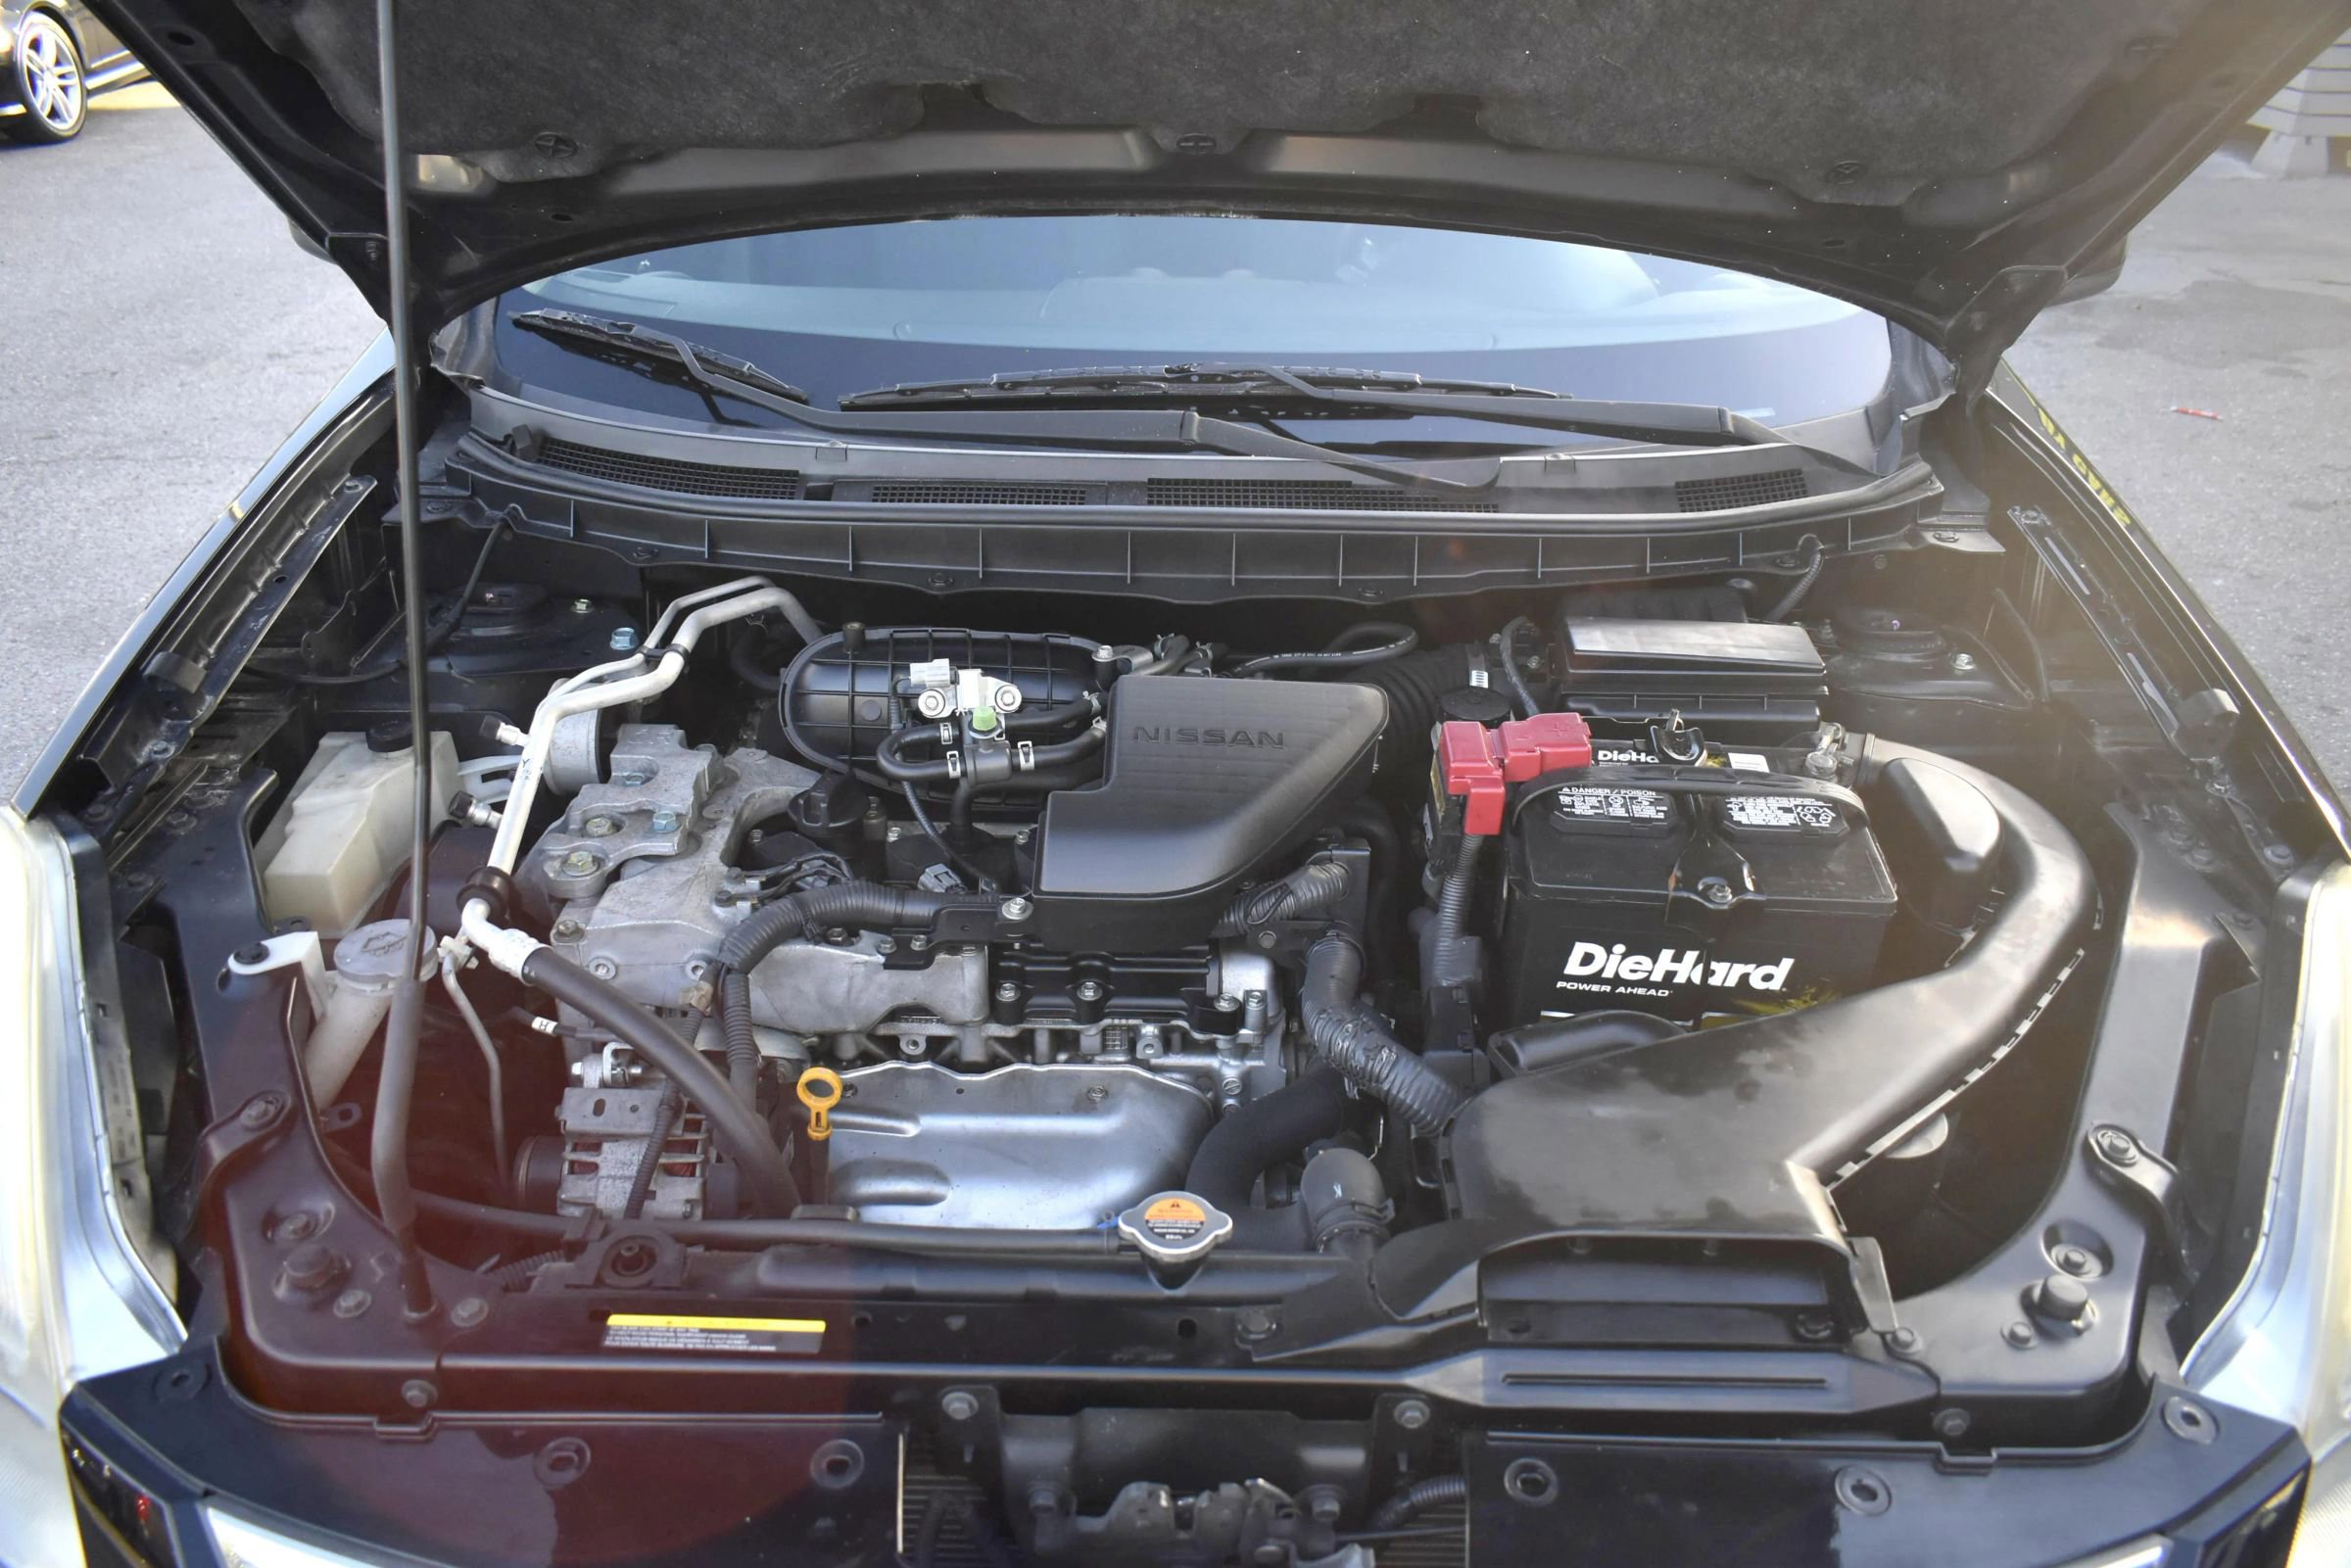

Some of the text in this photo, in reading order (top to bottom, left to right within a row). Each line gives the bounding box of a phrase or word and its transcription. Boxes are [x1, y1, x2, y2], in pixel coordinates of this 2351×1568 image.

[1133, 726, 1285, 749] NISSAN
[1598, 749, 1659, 764] DieHa
[1563, 941, 1795, 991] DieHard
[1556, 980, 1670, 997] POWER AHEAD
